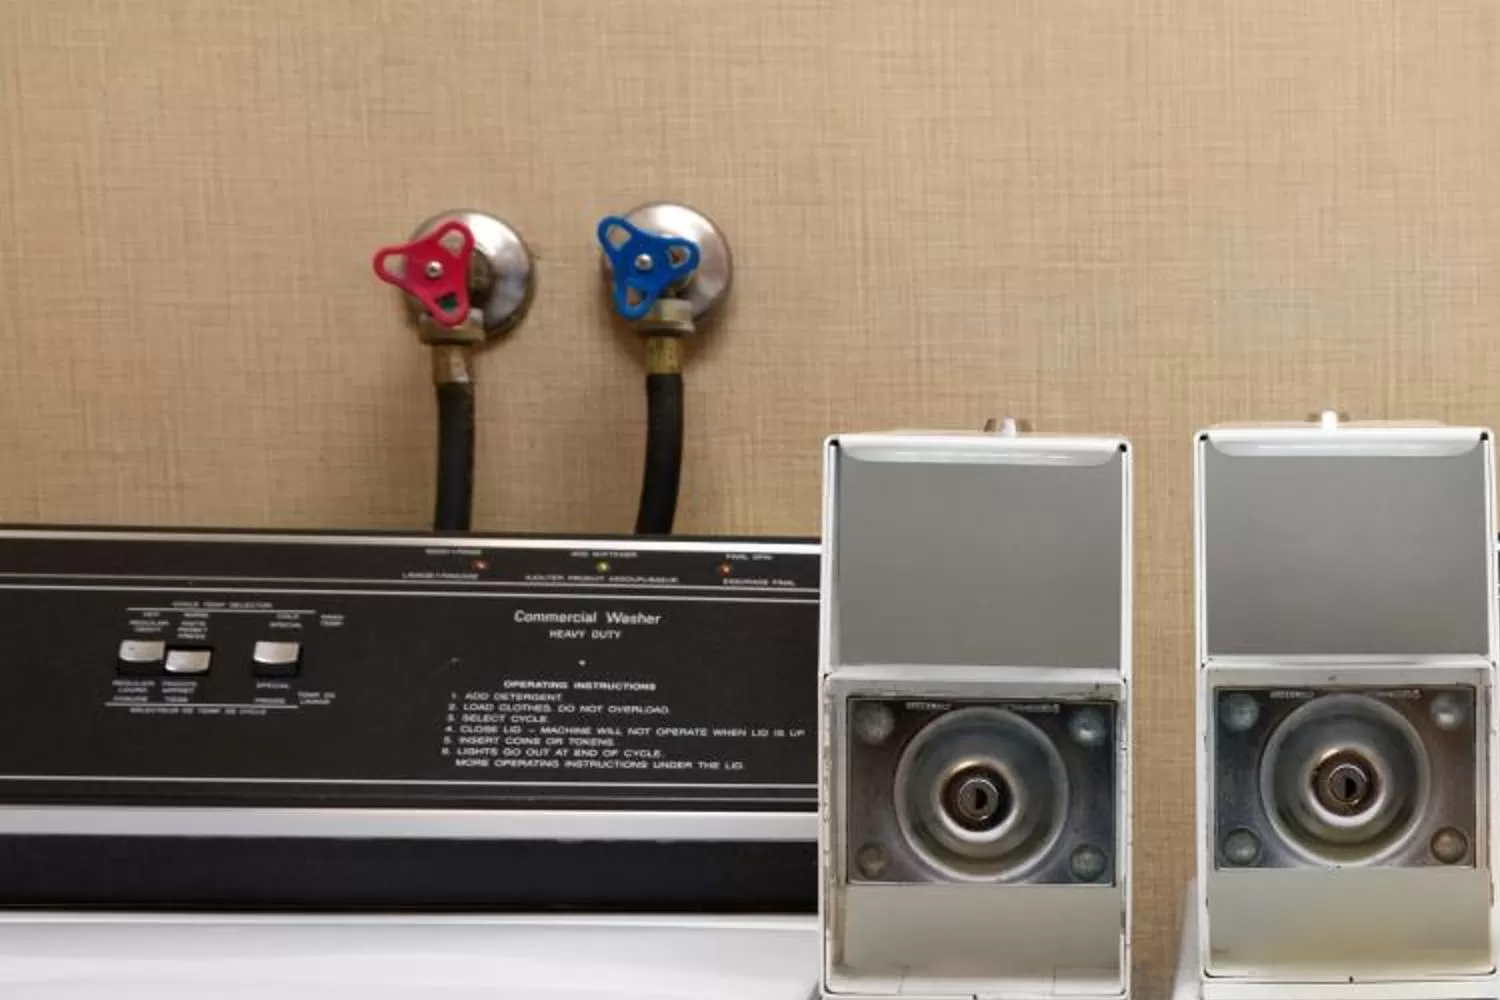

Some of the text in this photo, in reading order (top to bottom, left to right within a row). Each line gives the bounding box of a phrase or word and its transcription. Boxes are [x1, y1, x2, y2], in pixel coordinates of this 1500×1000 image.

[514, 611, 662, 625] Commercial Washer
[549, 629, 622, 640] HEAVY DUTY
[503, 680, 656, 691] OPERATING INSTRUCTIONS
